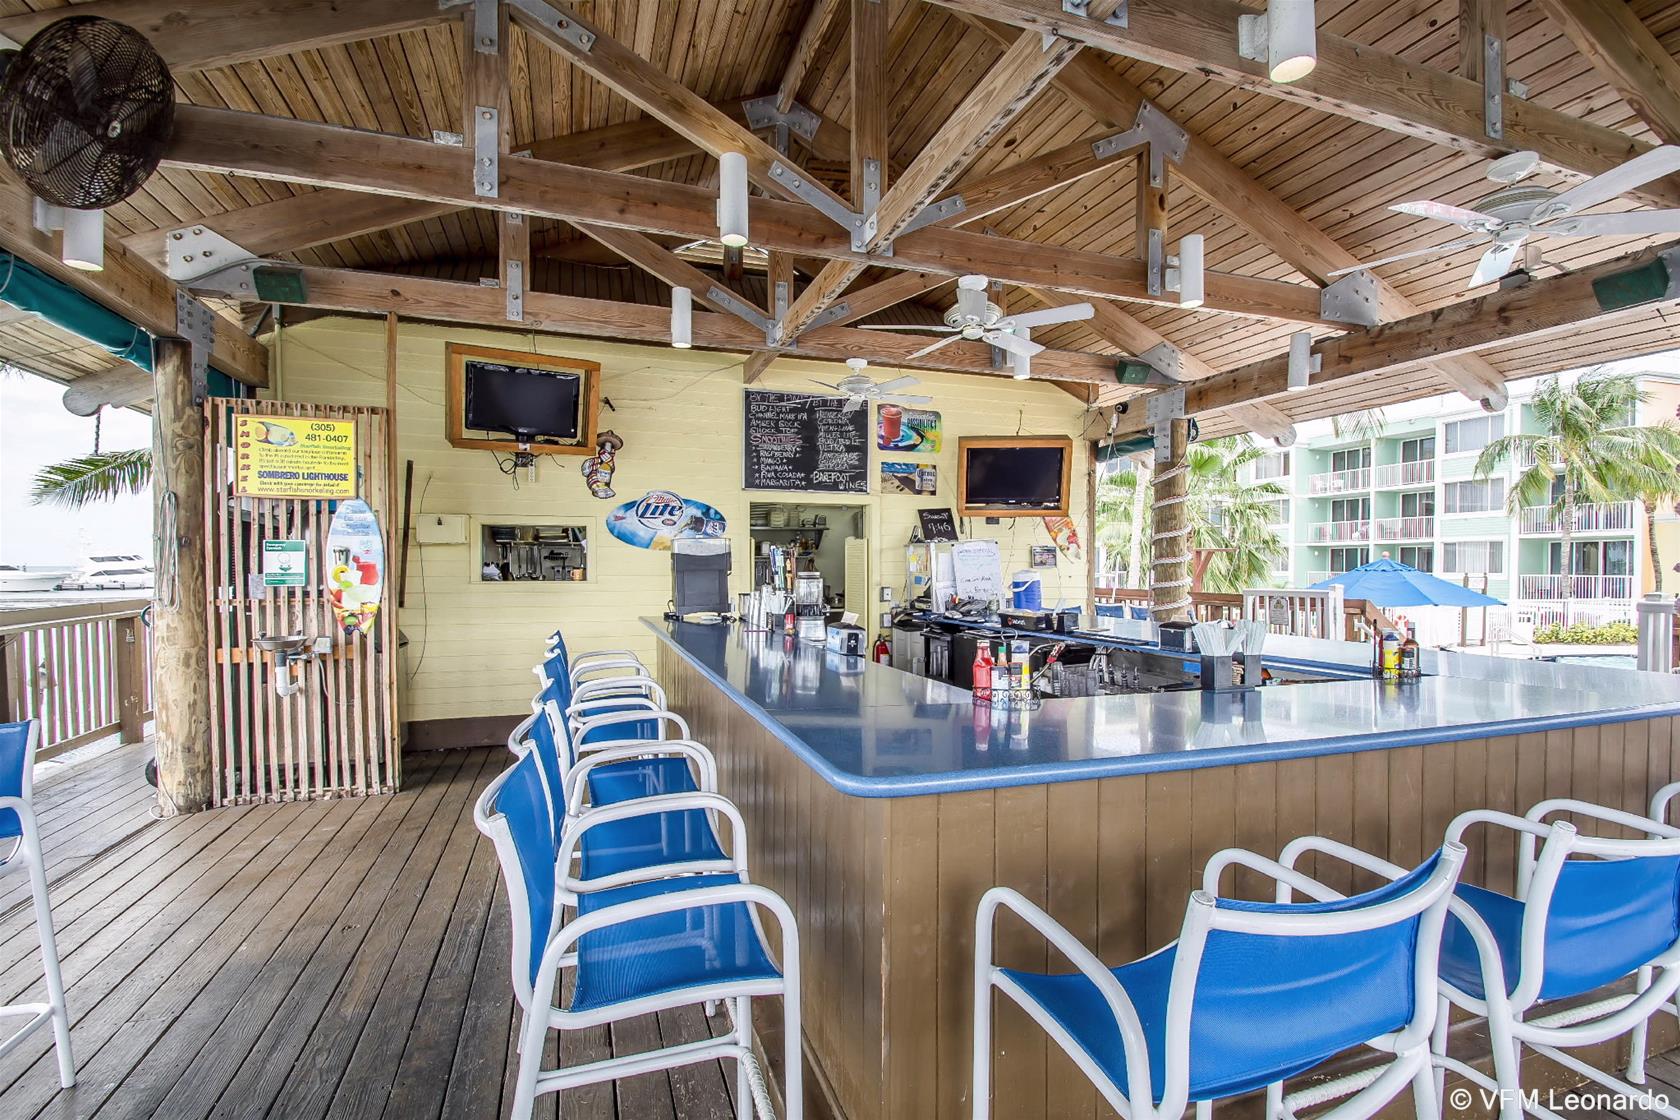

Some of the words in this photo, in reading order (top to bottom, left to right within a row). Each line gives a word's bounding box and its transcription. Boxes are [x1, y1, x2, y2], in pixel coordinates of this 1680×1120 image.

[750, 404, 768, 413] BUD
[769, 405, 792, 413] LIGHT
[310, 423, 336, 432] (305)
[305, 433, 348, 443] 481-0407
[750, 434, 803, 445] SMOOTHIES
[818, 444, 846, 452] ULTRA
[257, 470, 301, 480] SOMBRERO
[302, 471, 349, 482] LIGHTHOUSE
[812, 470, 856, 484] BAREFOOT
[760, 478, 802, 487] MARGARITA
[838, 480, 868, 490] WINES
[638, 502, 684, 519] Lite
